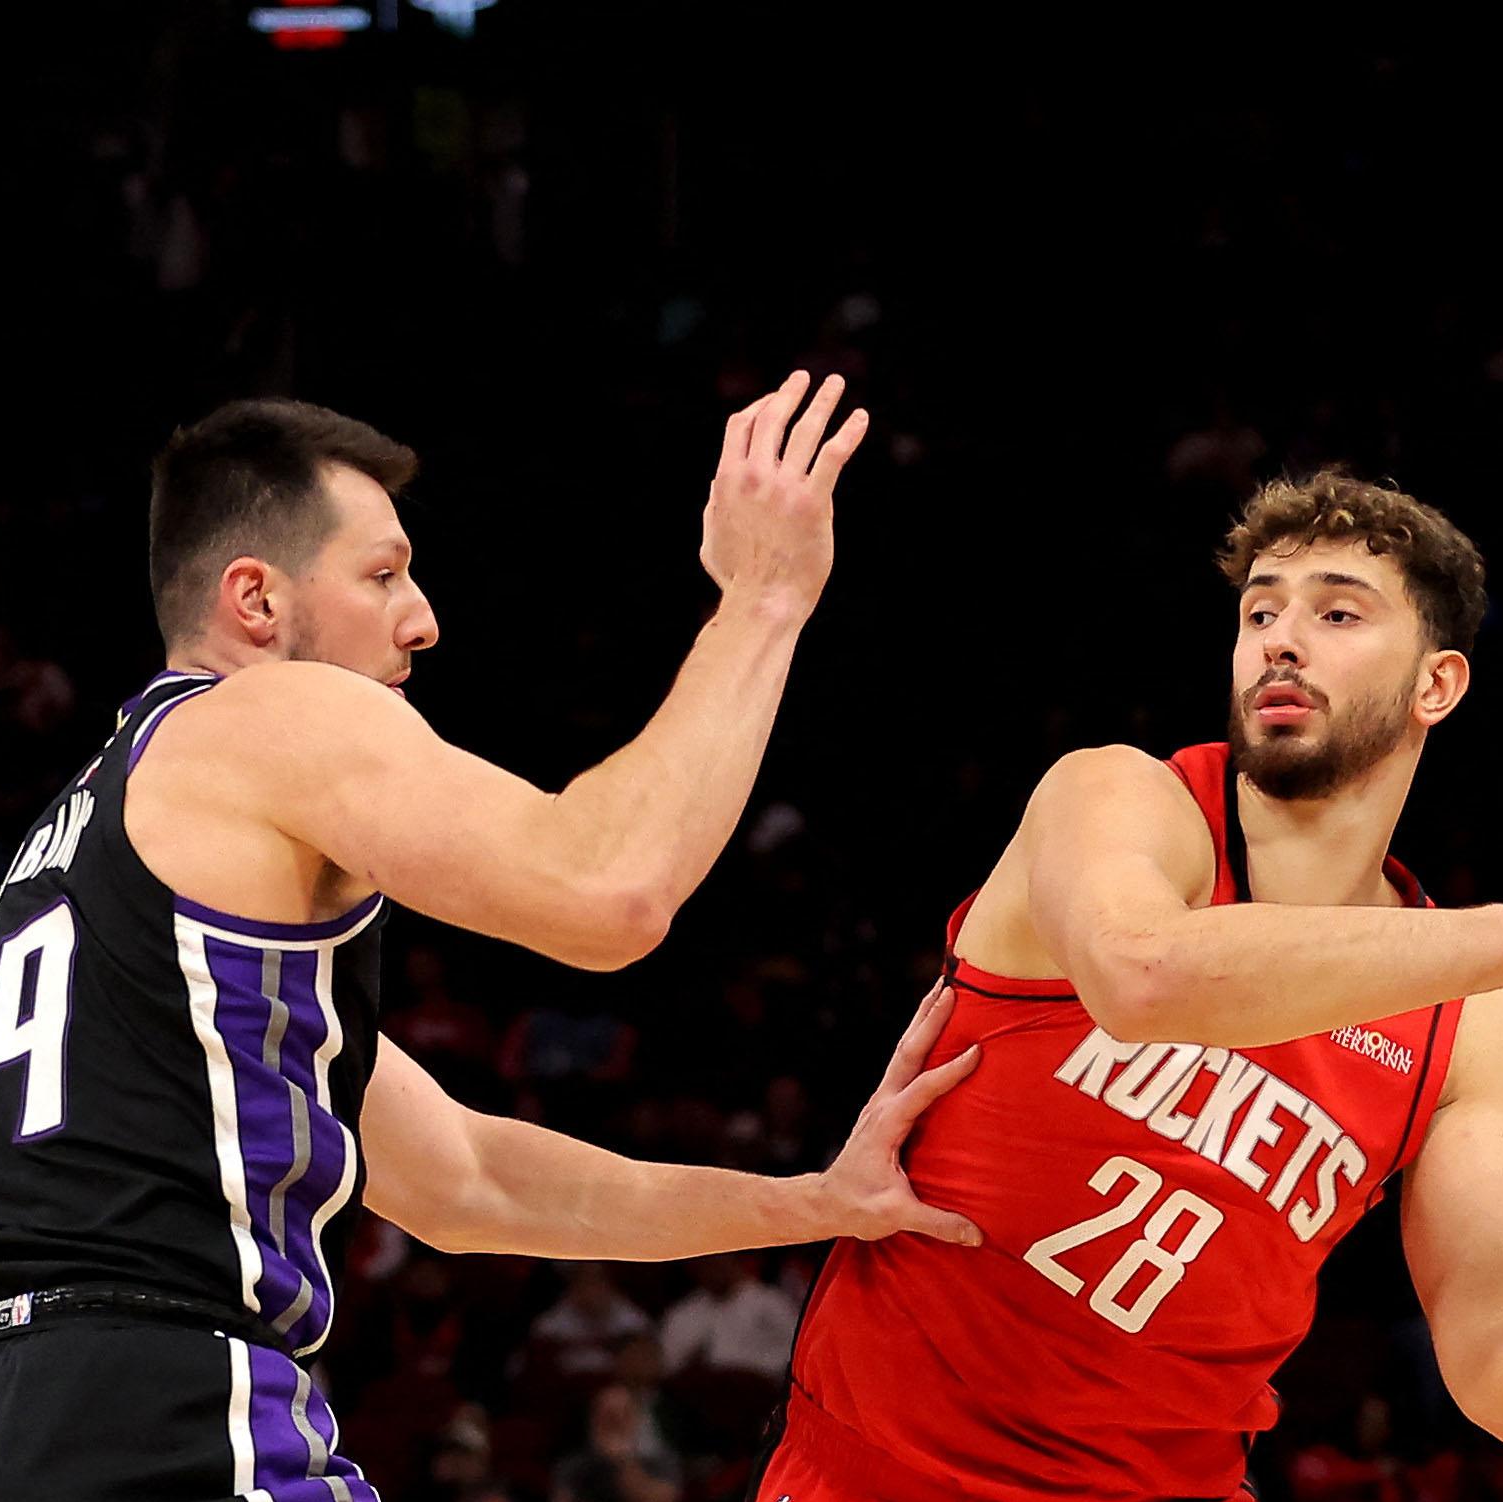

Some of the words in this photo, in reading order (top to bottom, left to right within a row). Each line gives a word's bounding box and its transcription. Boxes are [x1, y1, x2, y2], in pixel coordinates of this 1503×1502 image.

[1053, 1025, 1367, 1243] ROCKETS
[1329, 1029, 1414, 1075] HERMANN
[1023, 1156, 1224, 1334] 28
